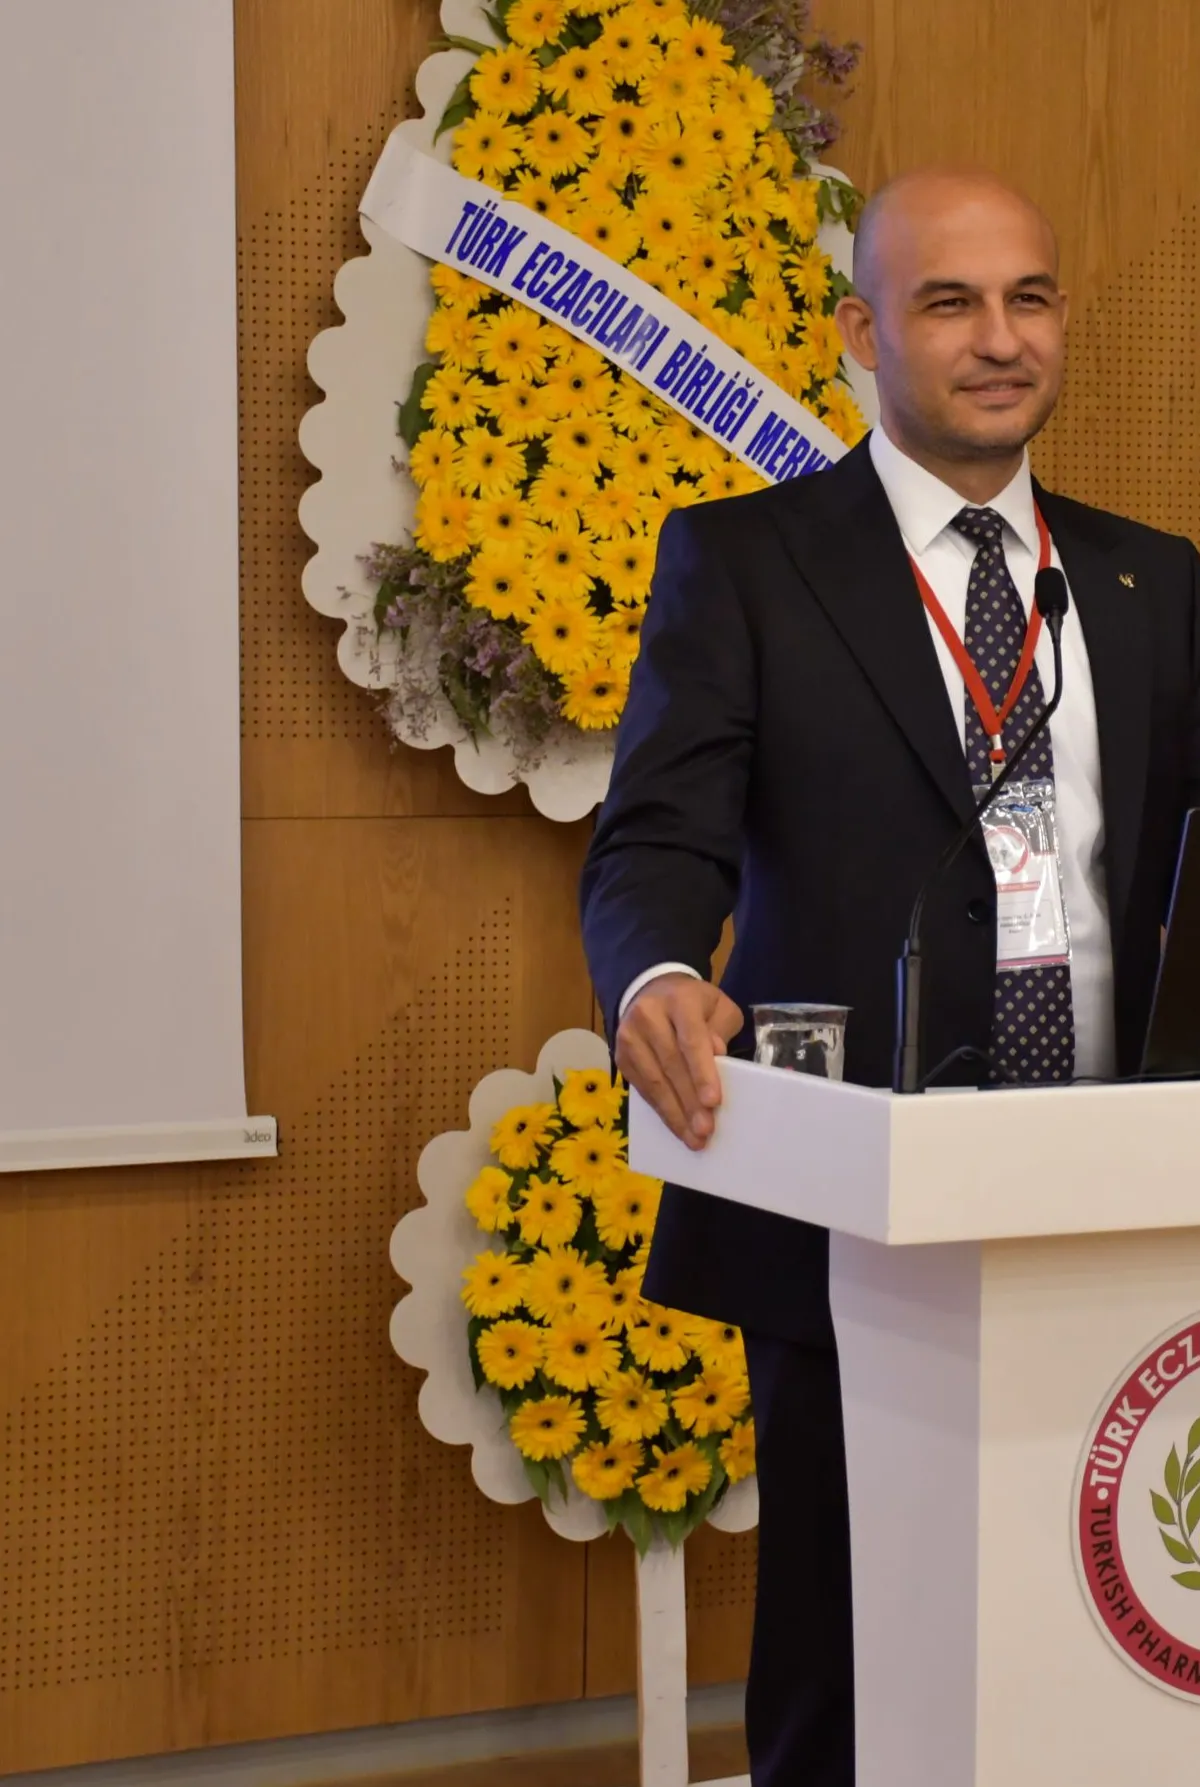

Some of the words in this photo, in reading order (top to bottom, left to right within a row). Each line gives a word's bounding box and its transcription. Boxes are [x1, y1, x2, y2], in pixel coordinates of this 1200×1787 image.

[444, 199, 529, 279] TÜRK
[511, 241, 671, 372] ECZACILARI
[653, 340, 763, 444] BİRLİĞİ
[1090, 1395, 1146, 1488] TÜRK
[1090, 1504, 1134, 1621] TURKISH
